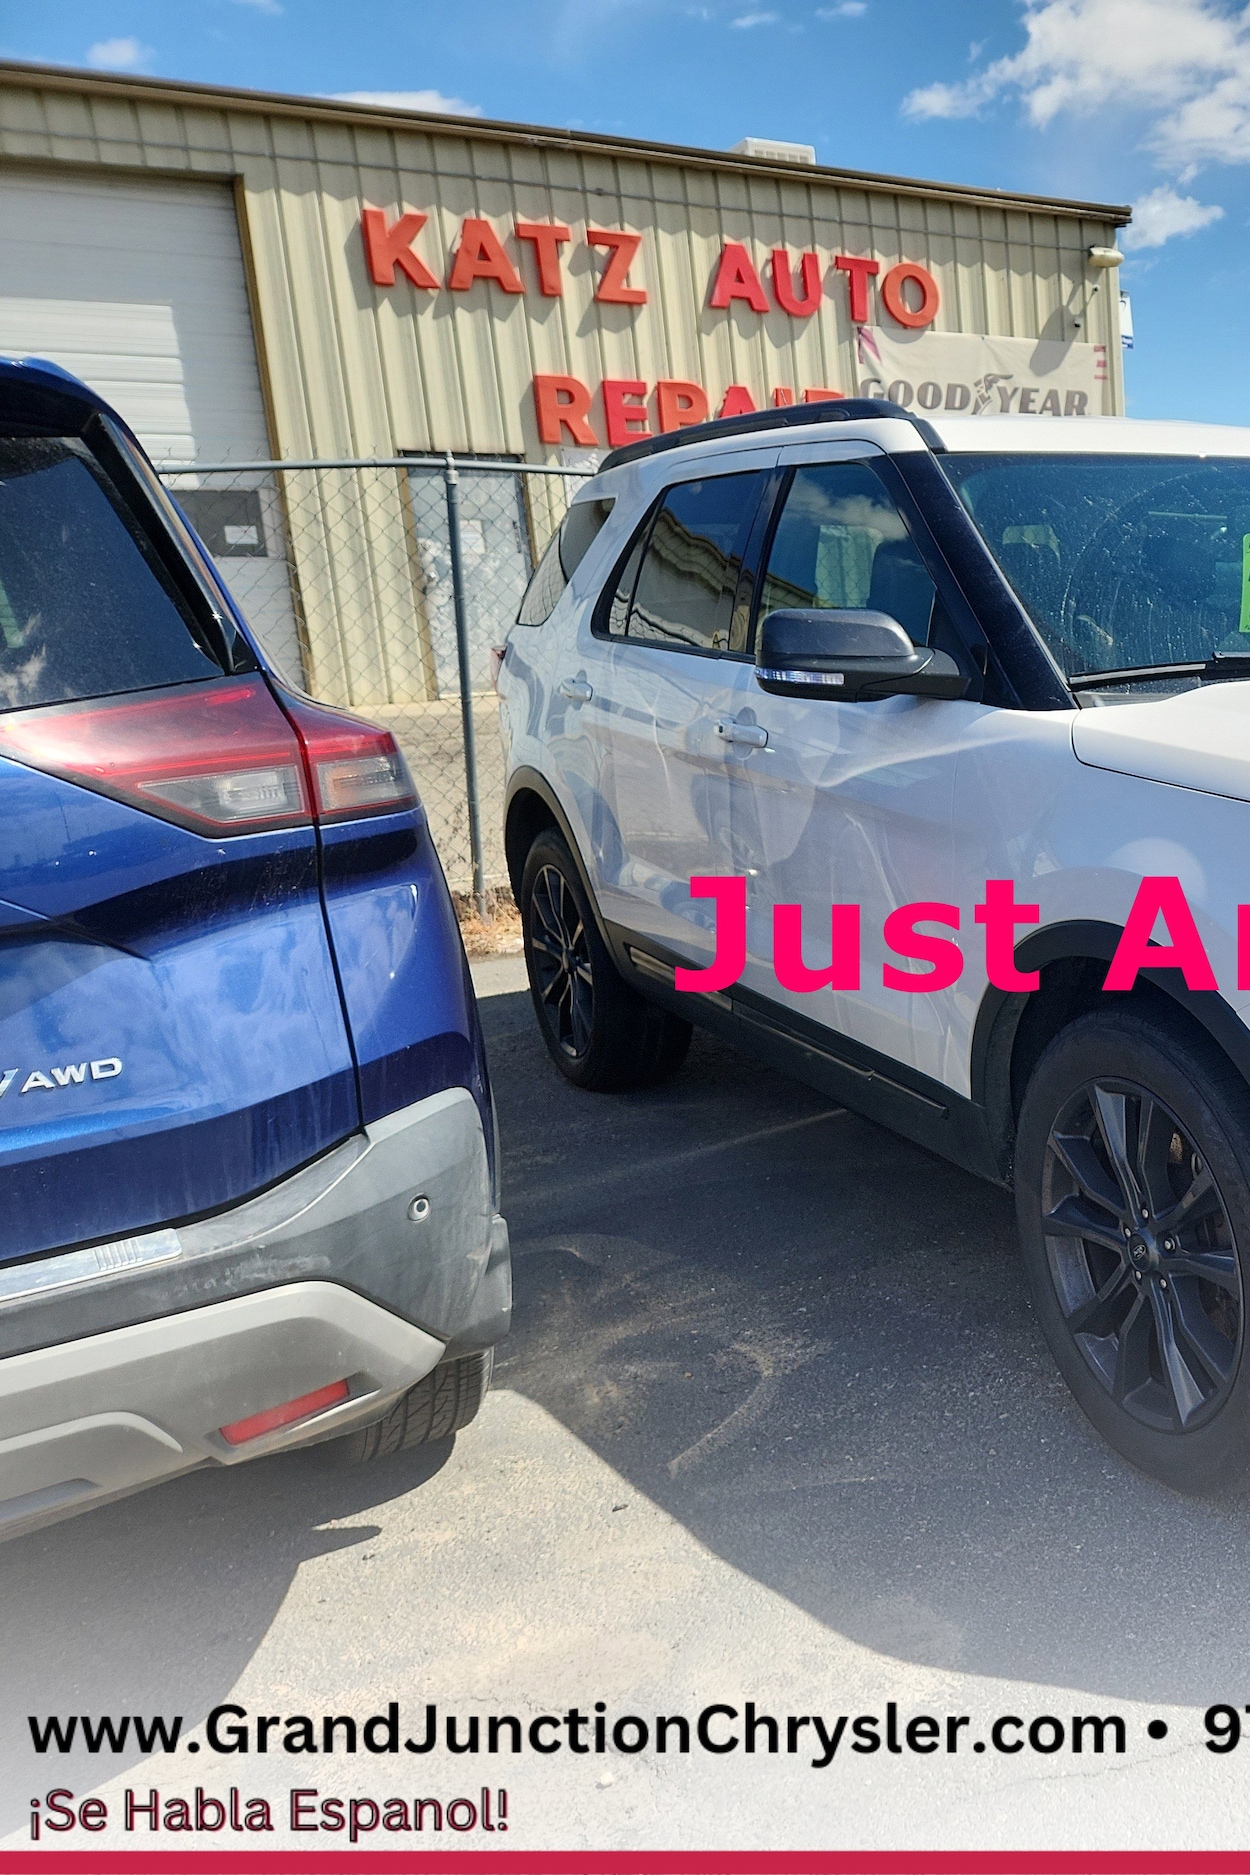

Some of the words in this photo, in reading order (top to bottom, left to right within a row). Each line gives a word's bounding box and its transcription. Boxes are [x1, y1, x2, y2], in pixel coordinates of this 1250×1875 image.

[362, 209, 648, 305] KATZ
[710, 243, 940, 329] AUTO
[533, 374, 846, 446] REPA
[20, 1056, 124, 1094] AWD
